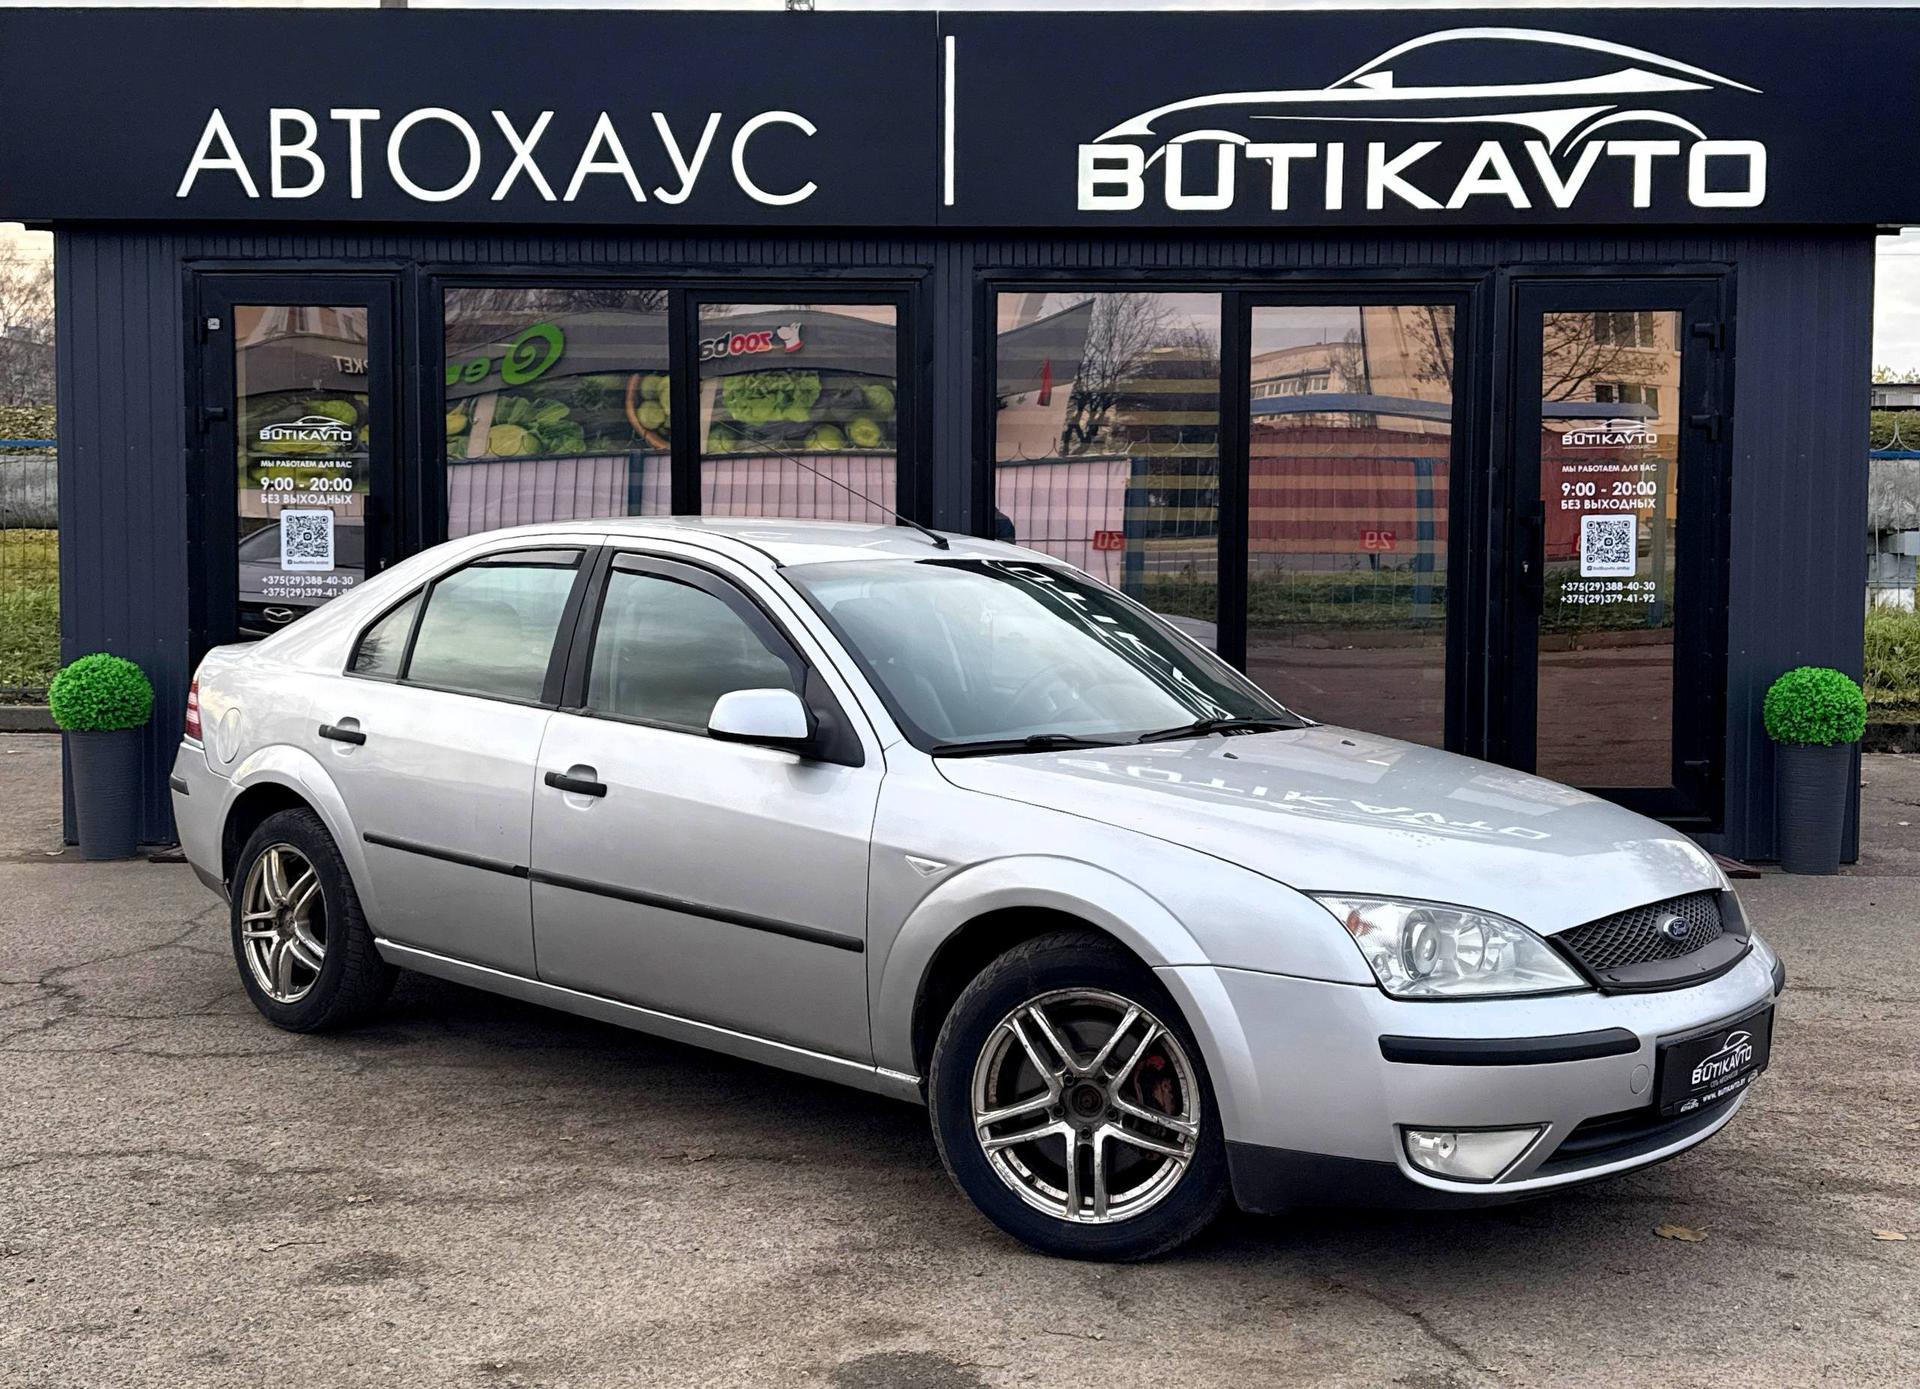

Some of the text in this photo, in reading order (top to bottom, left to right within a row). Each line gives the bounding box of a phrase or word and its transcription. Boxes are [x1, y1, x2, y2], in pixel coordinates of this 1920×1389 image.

[175, 107, 818, 206] АВТОХАУС
[1077, 138, 1768, 211] BUTIKAVTO
[259, 430, 353, 441] BUTIKAVTO
[1562, 433, 1658, 445] BUTIKAVTO
[276, 460, 317, 468] РАБОТАЕМ
[318, 460, 334, 468] ДЛЯ
[336, 460, 352, 468] ВАС
[1578, 464, 1619, 472] РАБОТАЕМ
[1621, 464, 1638, 472] ДЛЯ
[260, 477, 294, 491] 9:00
[310, 477, 353, 491] 20:00
[1562, 482, 1596, 496] 9:00
[1612, 481, 1657, 496] 20:00
[261, 493, 353, 505] БЕЗ ВЫХОДНЫХ
[1561, 498, 1656, 510] БЕЗ ВЫХОДНЫХ
[261, 576, 354, 586] +375(29)388-40-30
[1560, 581, 1656, 593] +375(29)388-40-30
[1560, 594, 1655, 605] +375(29)379-41-92
[1691, 1045, 1752, 1085] BUTIKAVTO
